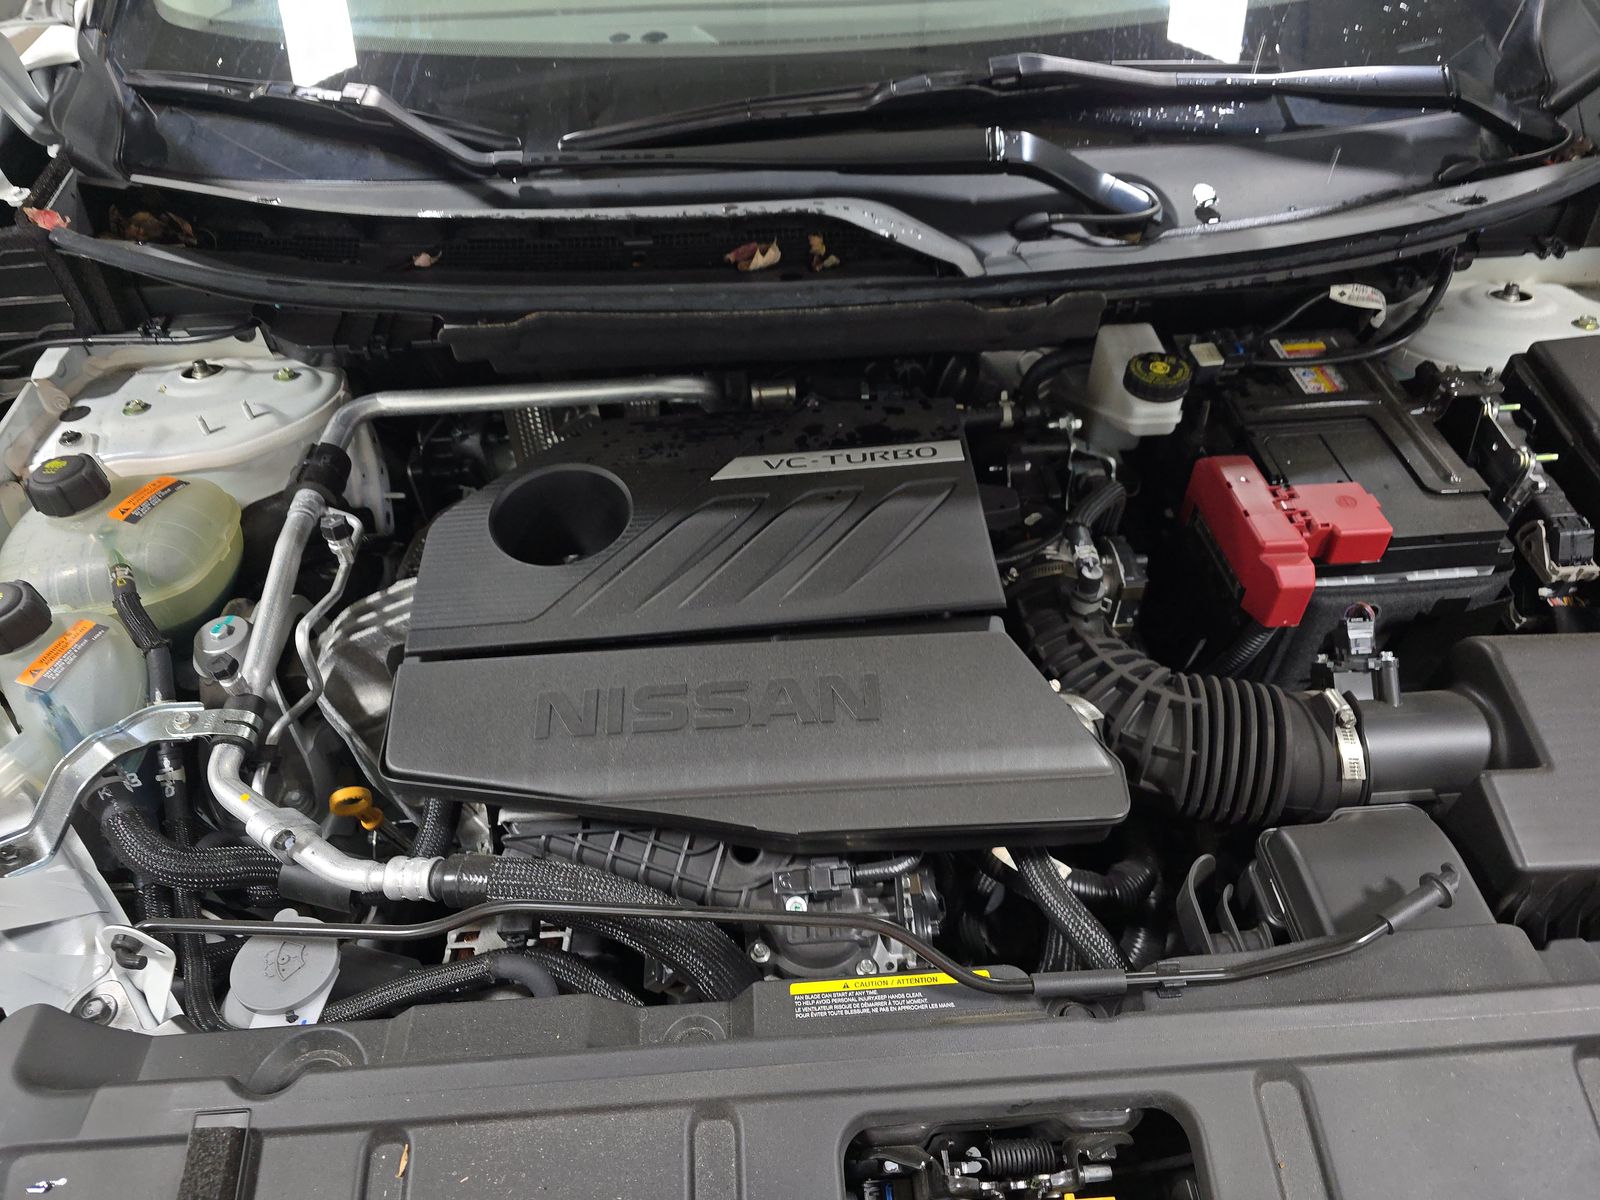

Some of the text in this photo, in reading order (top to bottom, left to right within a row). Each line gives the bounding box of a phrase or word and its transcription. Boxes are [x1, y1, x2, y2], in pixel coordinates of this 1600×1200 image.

[763, 446, 937, 470] VC-TURBO
[534, 673, 881, 739] NISSAN
[854, 980, 888, 988] CAUTION
[896, 976, 938, 985] ATTENTION
